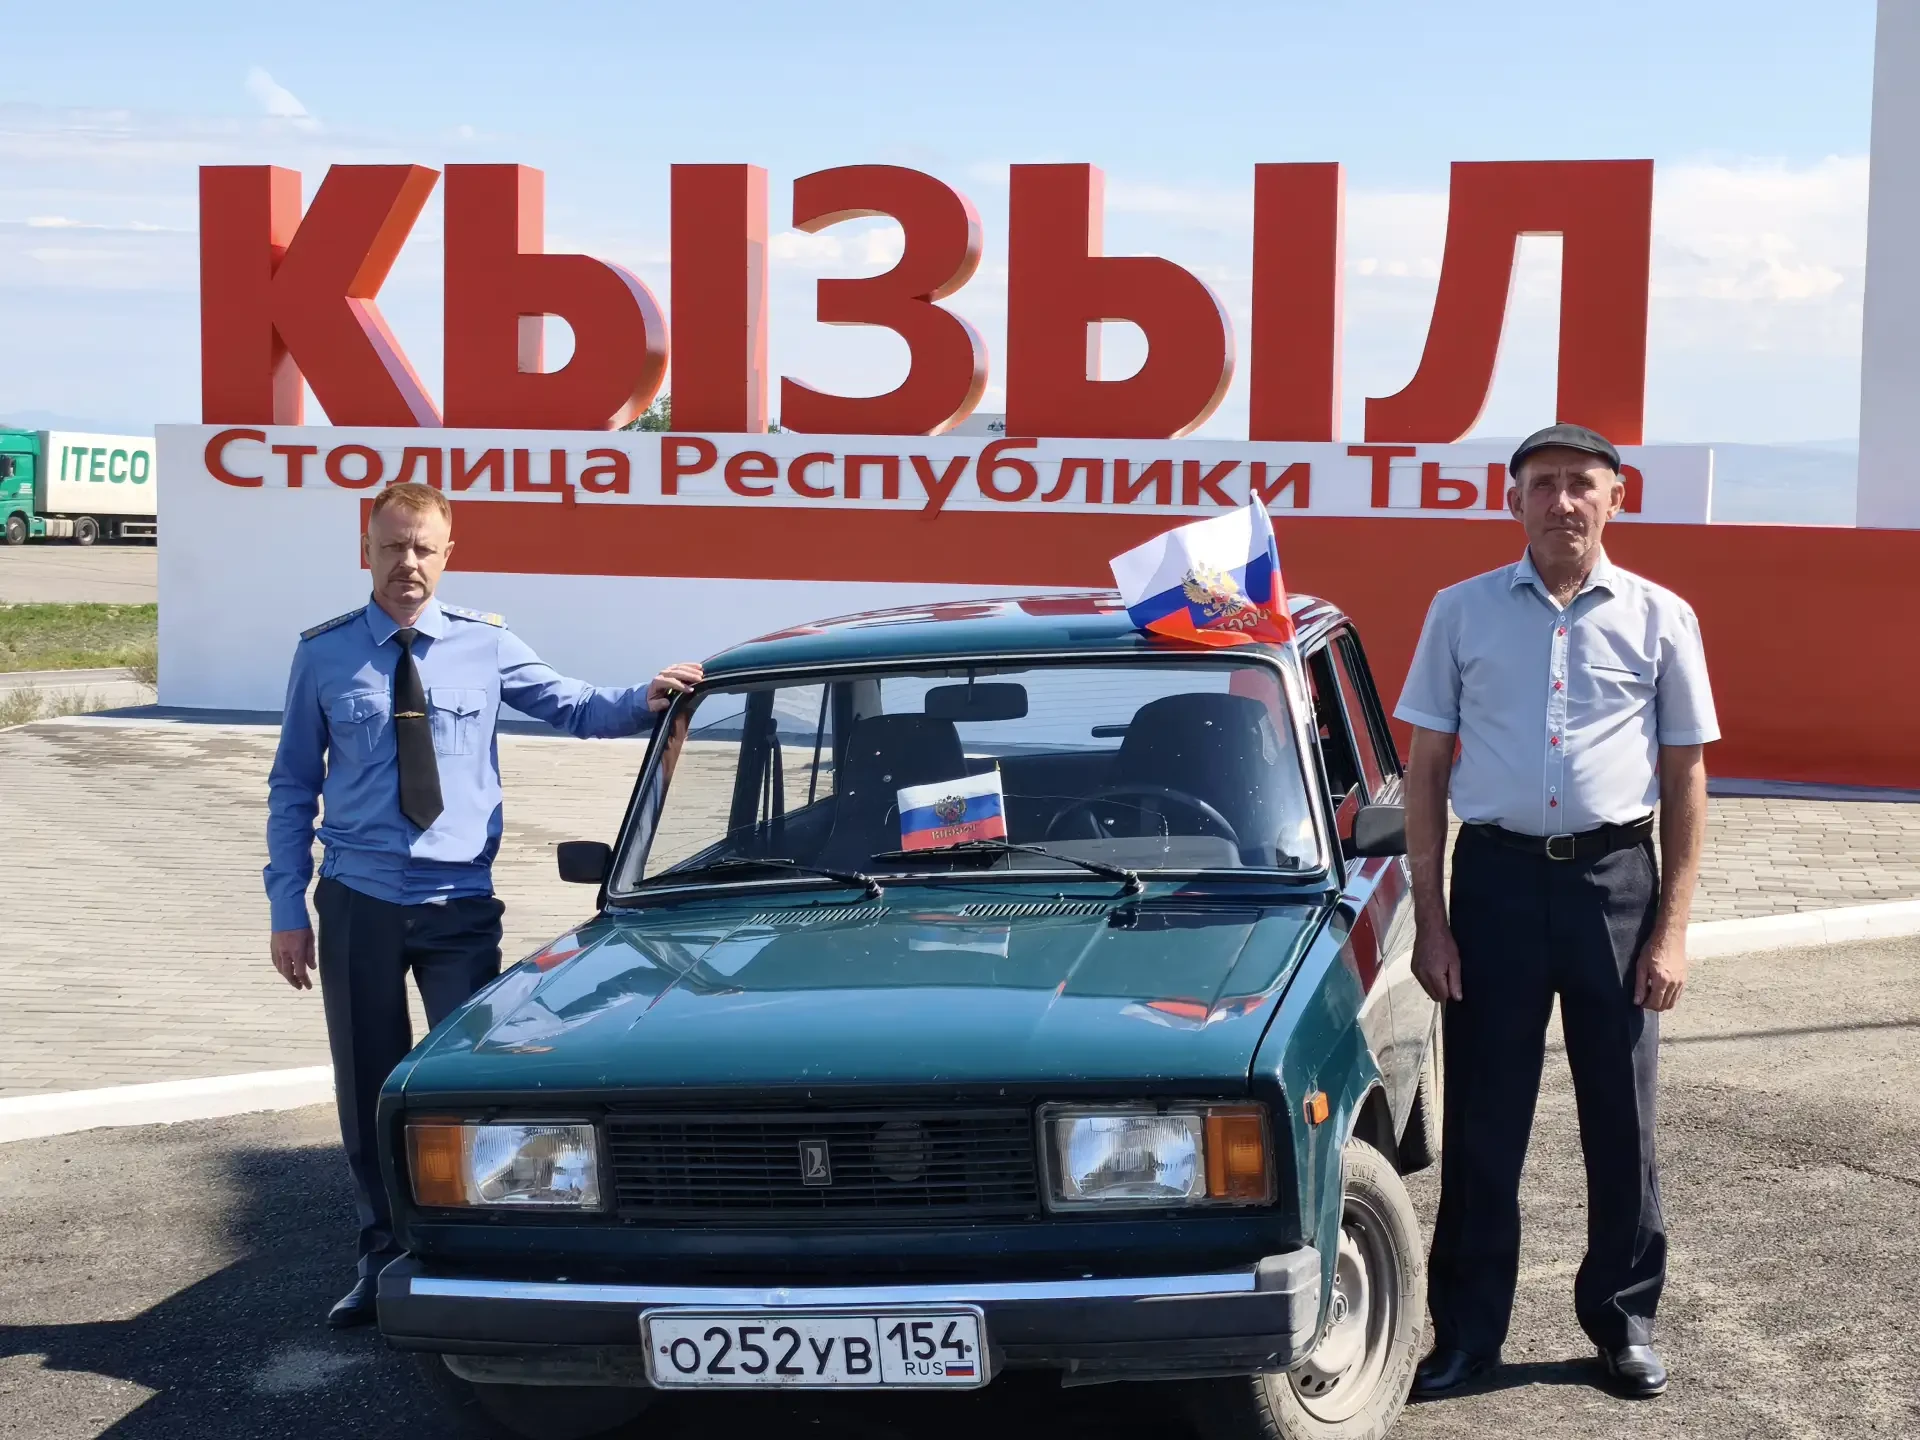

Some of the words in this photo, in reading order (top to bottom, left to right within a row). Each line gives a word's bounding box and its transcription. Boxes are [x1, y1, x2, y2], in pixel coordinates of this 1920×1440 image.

[199, 159, 1654, 445] КЫЗЫЛ
[60, 445, 150, 485] ITECO
[204, 427, 631, 507] Столица
[660, 436, 1311, 519] Республики
[1347, 445, 1644, 514] Ты
[886, 1321, 964, 1360] 154
[905, 1361, 944, 1376] RUS
